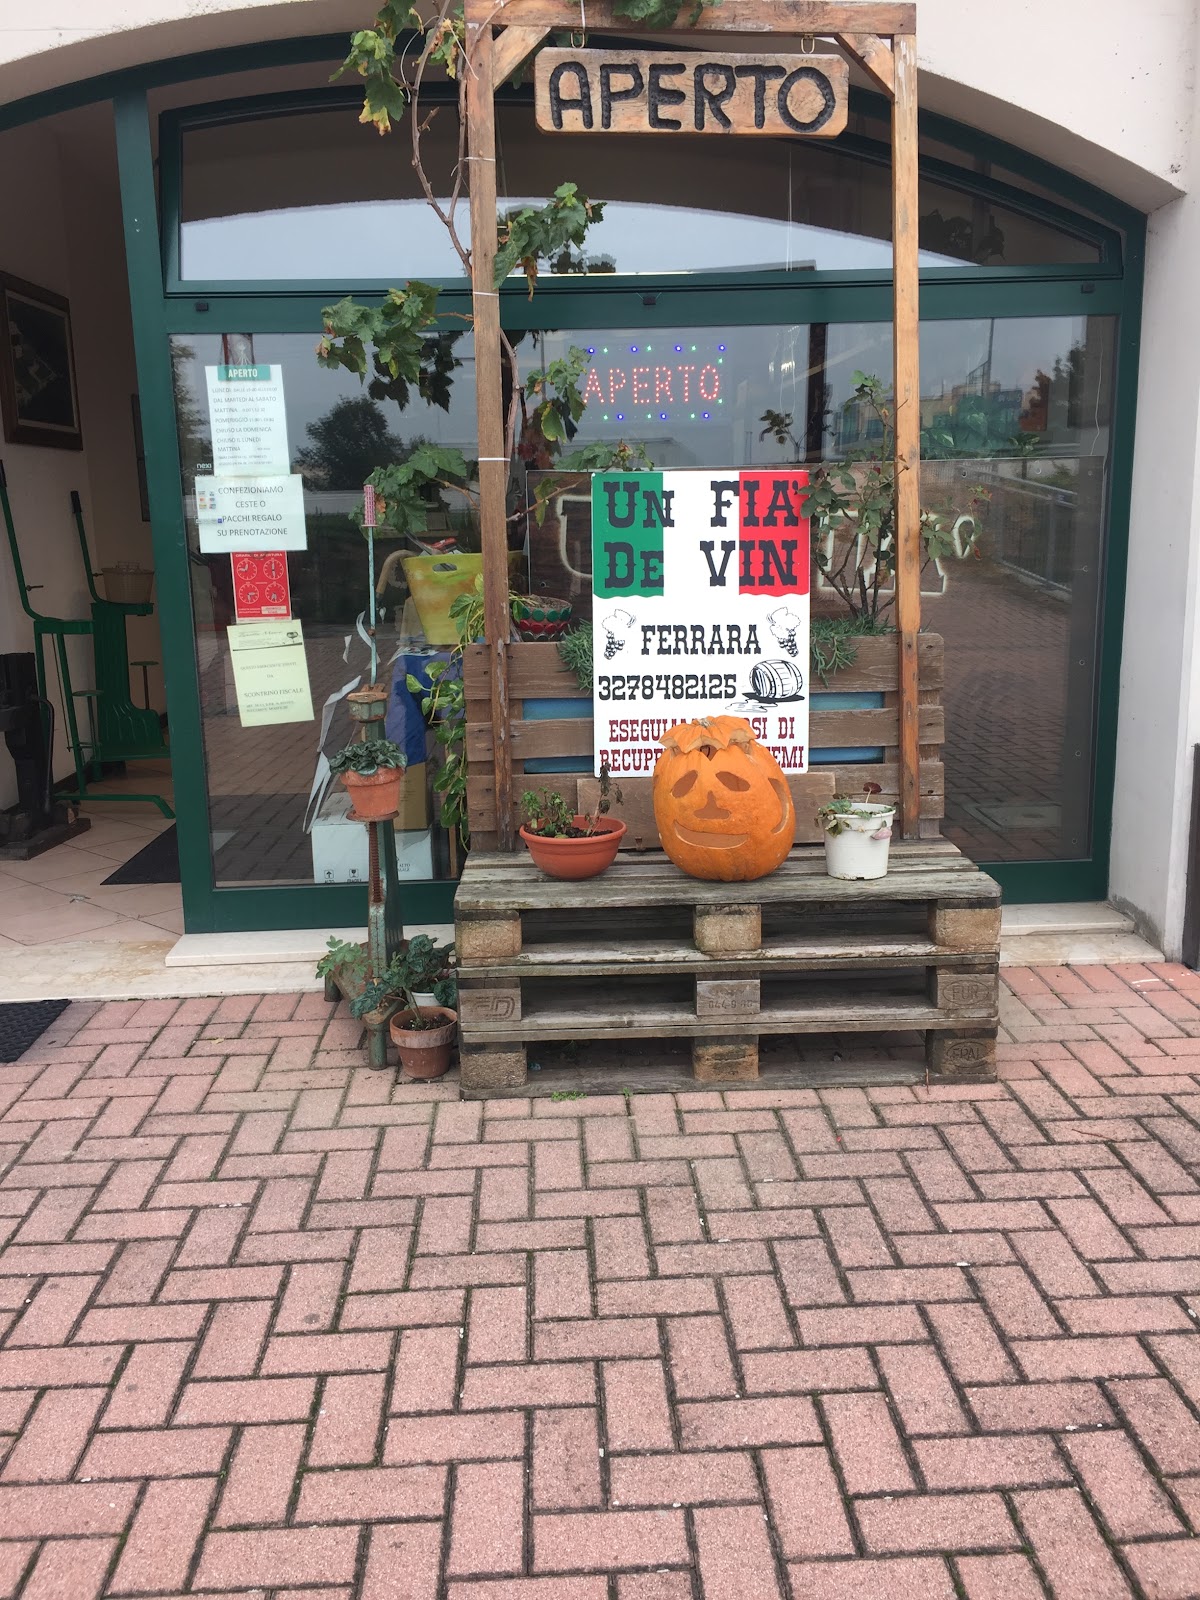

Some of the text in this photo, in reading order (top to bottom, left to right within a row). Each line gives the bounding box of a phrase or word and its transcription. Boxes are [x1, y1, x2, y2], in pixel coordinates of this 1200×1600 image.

[550, 61, 836, 133] APERTO
[228, 368, 258, 378] APERTO
[584, 364, 720, 404] APERTO
[218, 485, 284, 495] CONFEZIONIAMO
[235, 500, 266, 508] CESTE O
[222, 513, 283, 523] PACCHI REGALO
[217, 527, 288, 537] SU PRENOTAZIONE
[700, 540, 797, 587] VIN
[641, 624, 762, 655] FERRARA
[244, 687, 304, 698] SCONTRINO FISCALE
[598, 673, 737, 701] 3278482125
[744, 716, 767, 739] SI
[778, 716, 795, 739] DI
